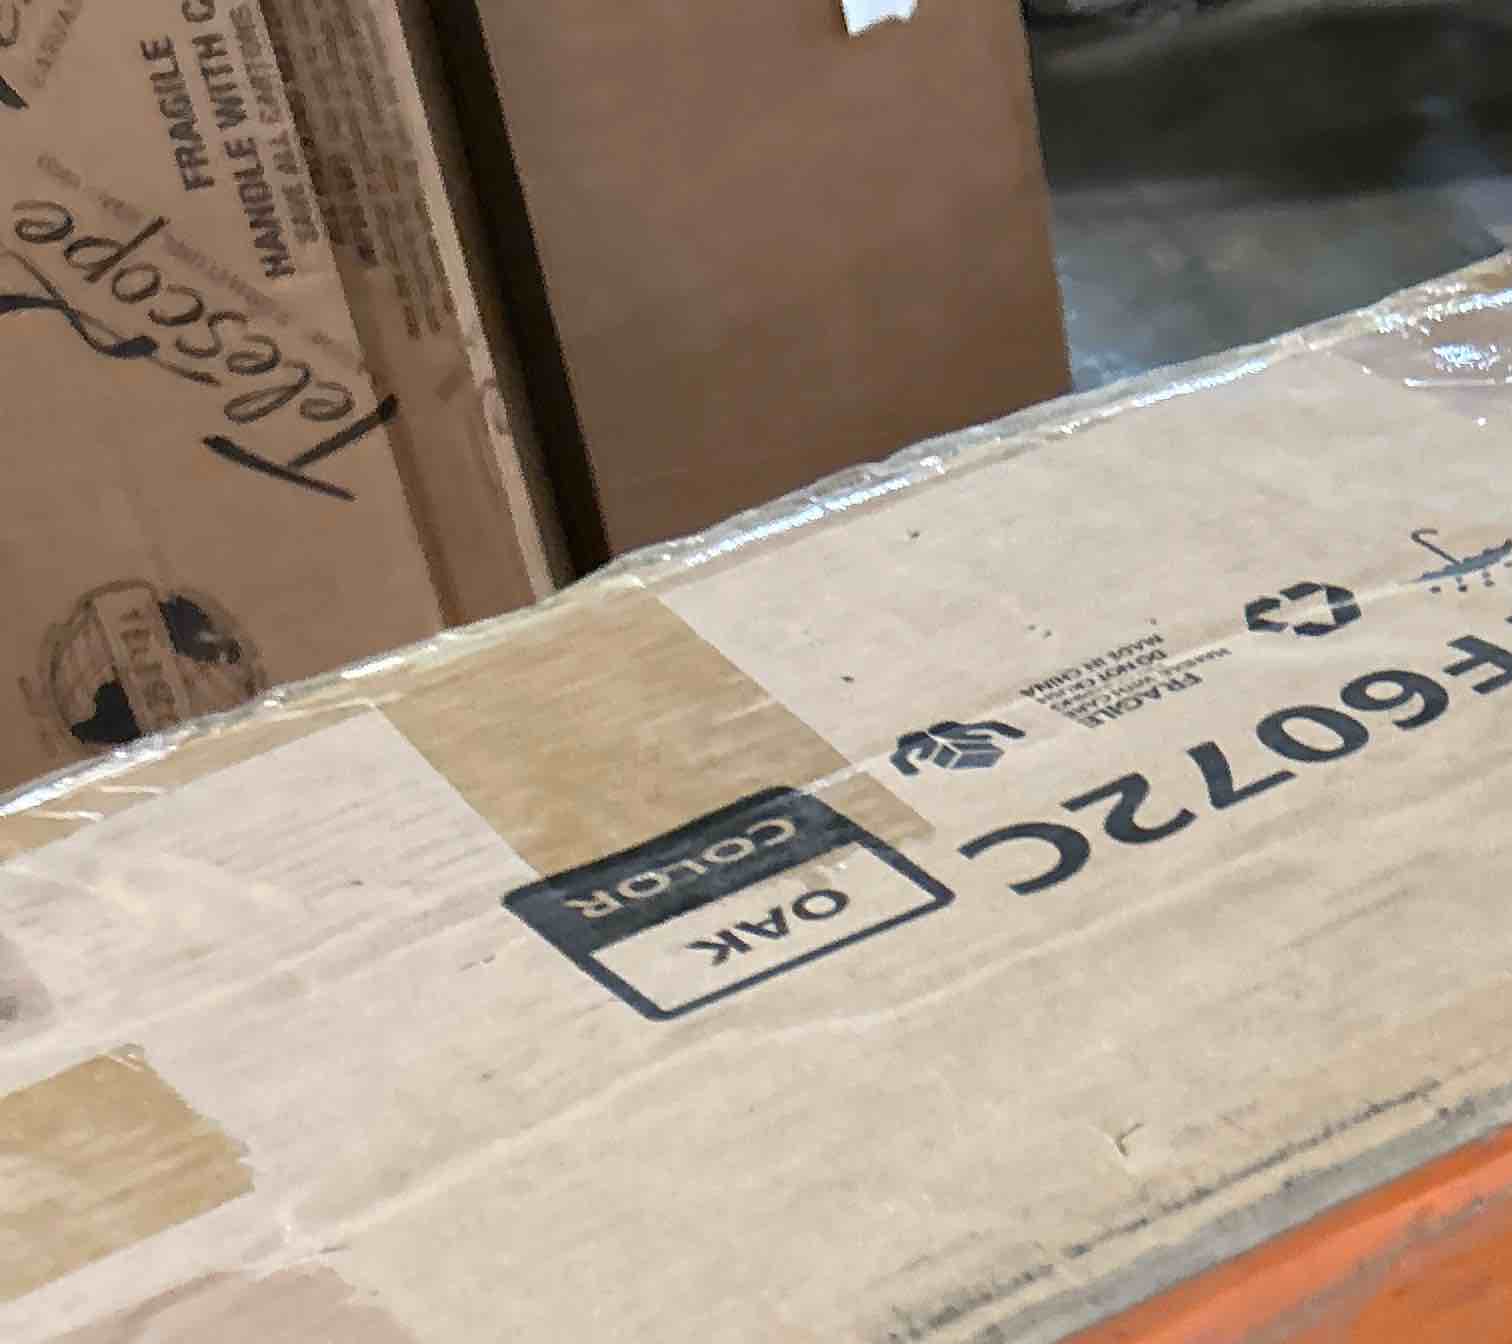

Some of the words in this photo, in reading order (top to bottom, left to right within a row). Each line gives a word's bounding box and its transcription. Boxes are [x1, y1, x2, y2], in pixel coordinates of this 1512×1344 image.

[139, 36, 216, 191] FRAGILE
[192, 33, 248, 131] WITH
[223, 137, 297, 279] HANDLE
[13, 200, 398, 502] Telescope
[1018, 667, 1083, 697] CHINA
[1077, 671, 1203, 729] FRAGILE
[561, 816, 798, 920] COLOR
[687, 887, 850, 967] OAK
